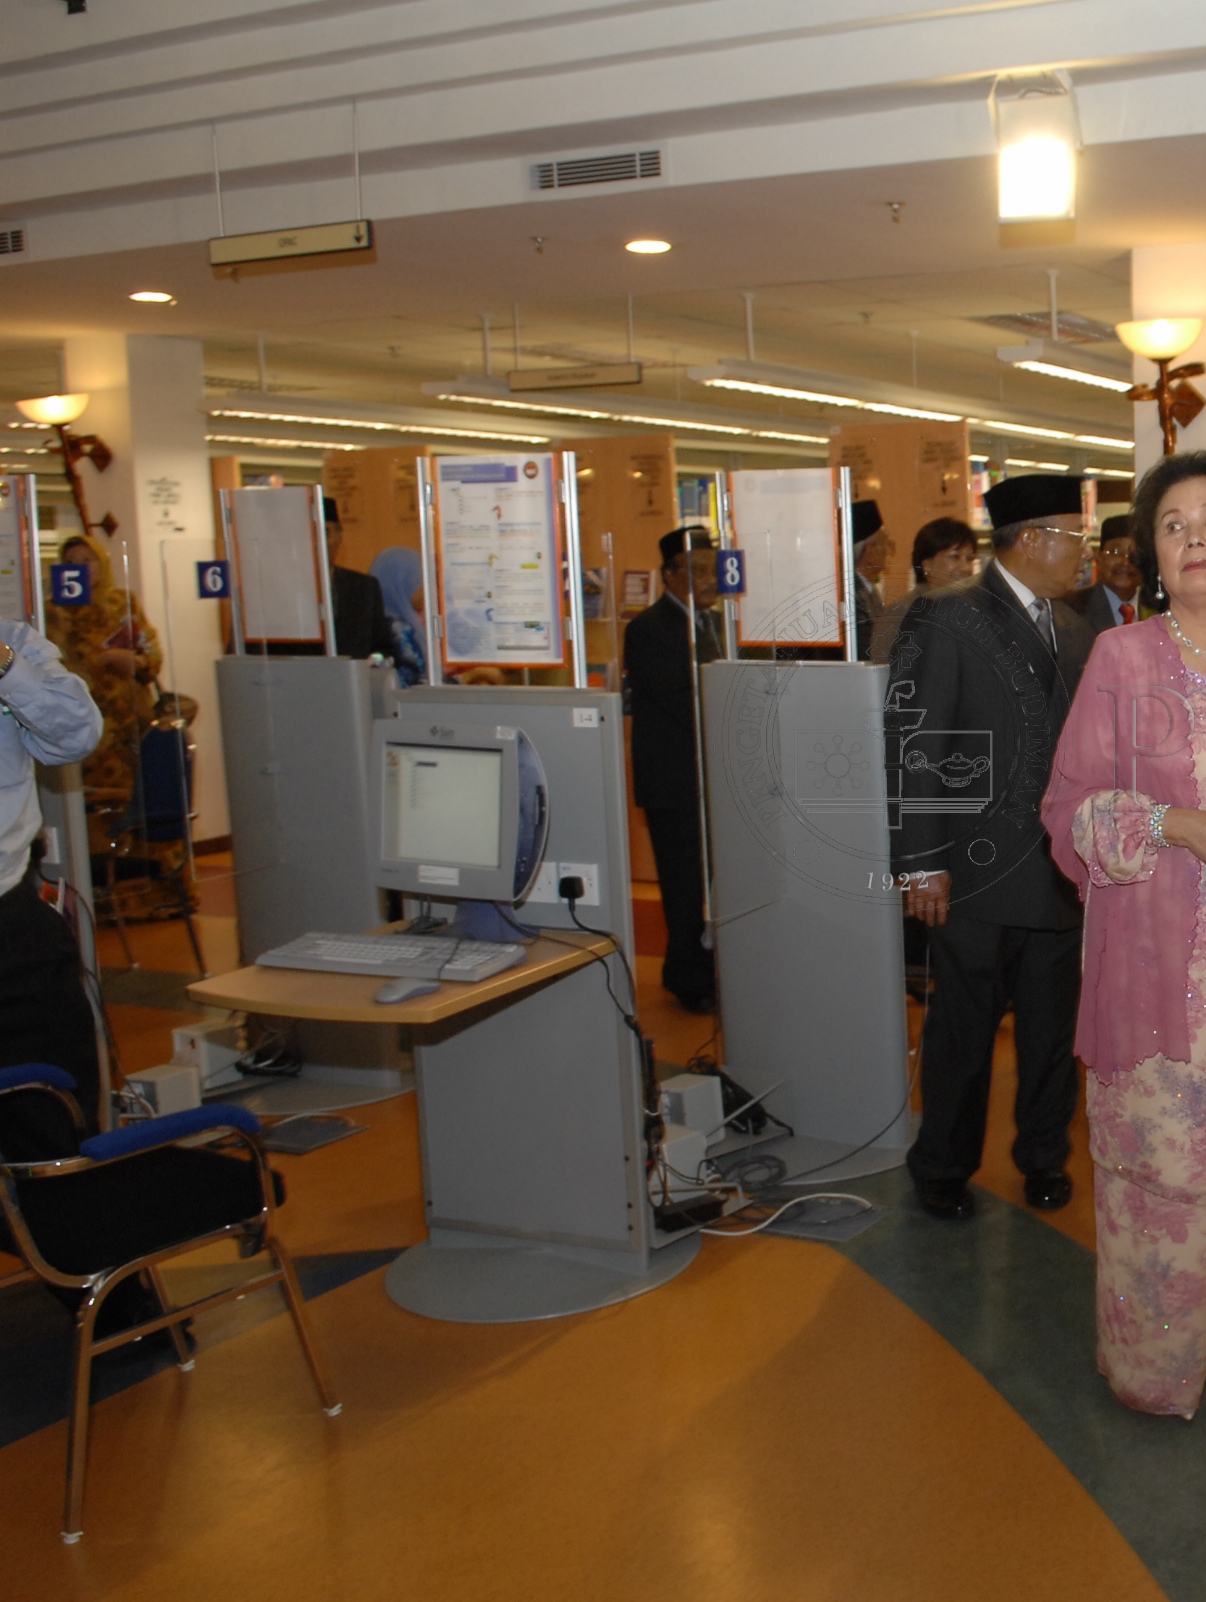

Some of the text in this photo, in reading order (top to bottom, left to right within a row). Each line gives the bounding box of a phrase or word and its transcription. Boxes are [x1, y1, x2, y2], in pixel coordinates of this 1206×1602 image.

[61, 570, 84, 598] 5
[205, 566, 224, 592] 6
[726, 556, 741, 586] 8
